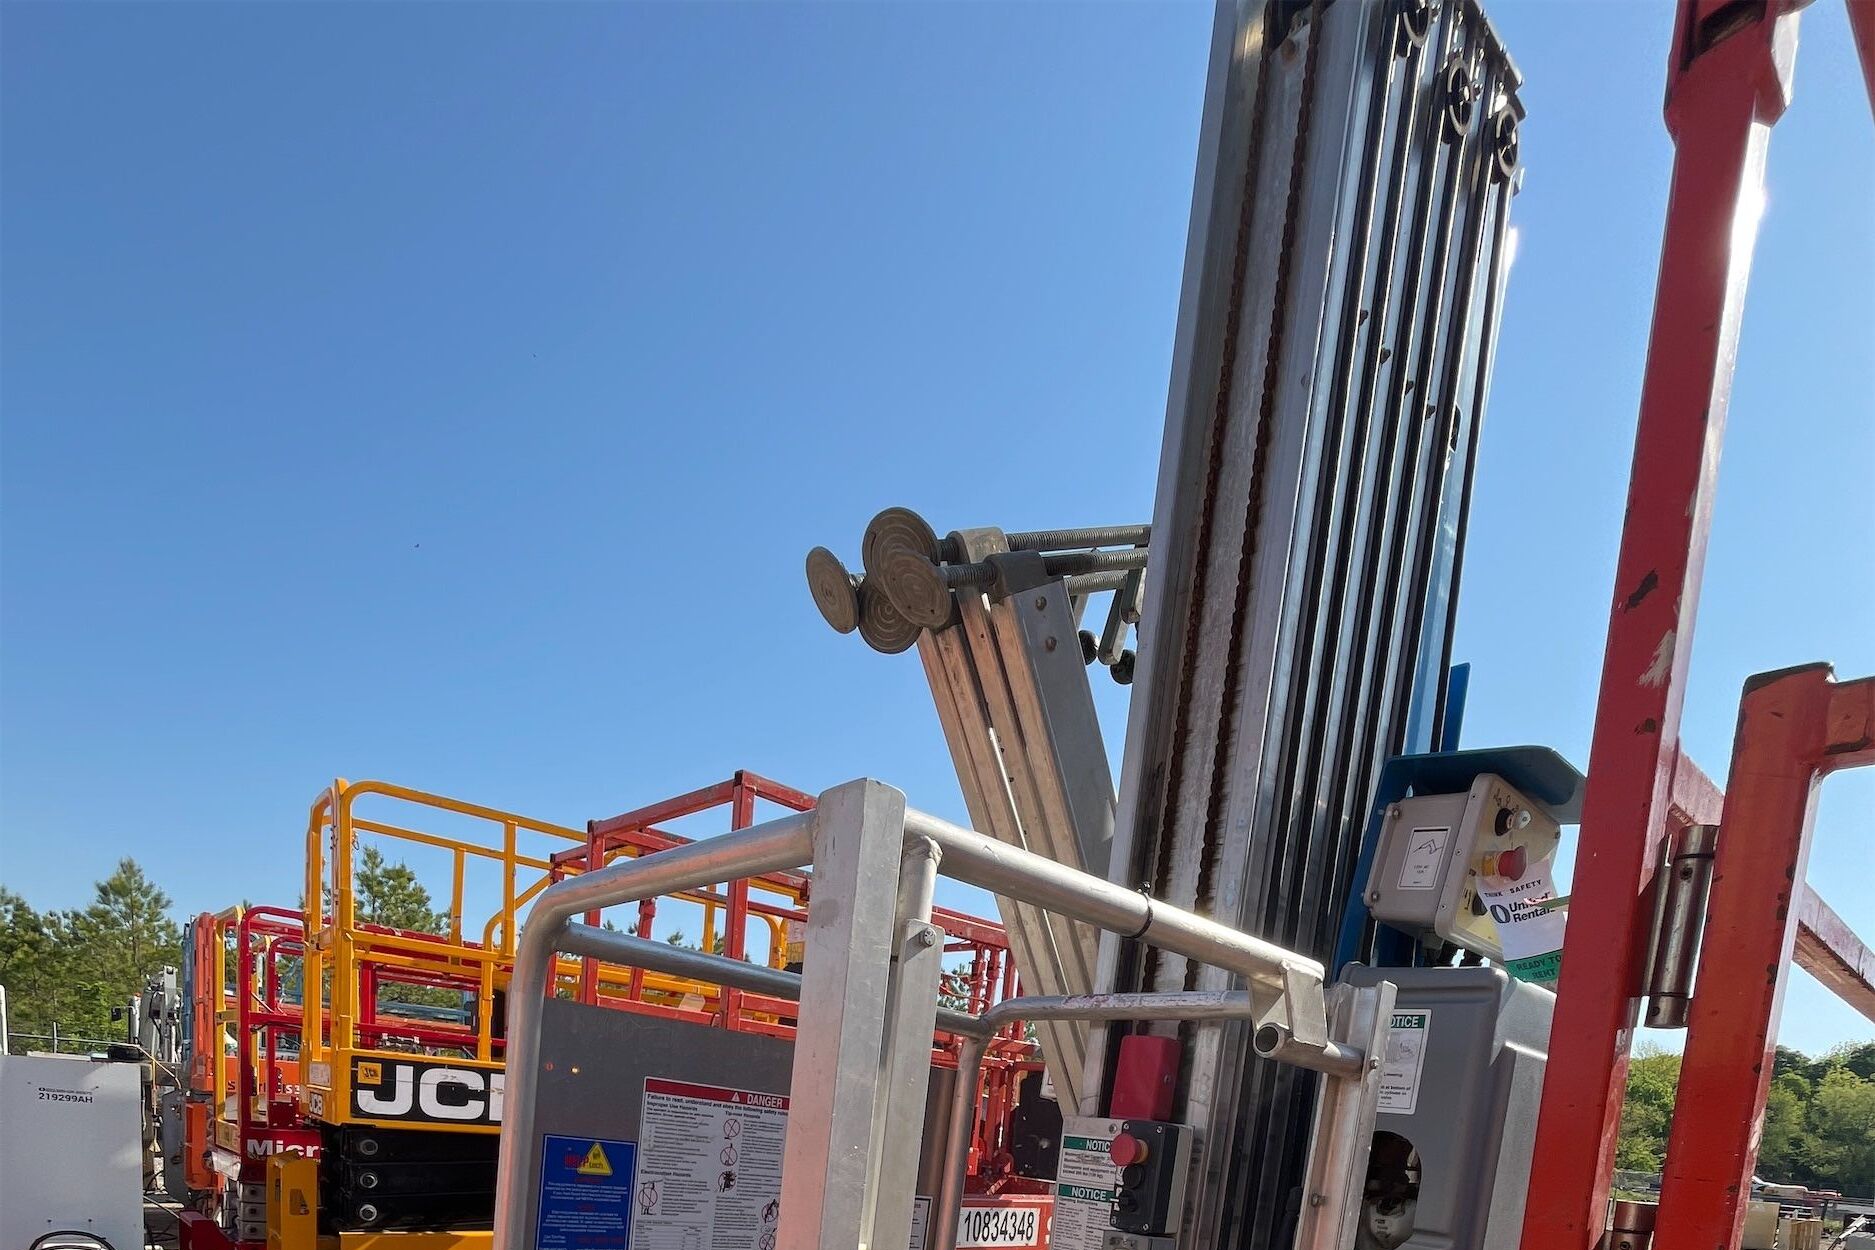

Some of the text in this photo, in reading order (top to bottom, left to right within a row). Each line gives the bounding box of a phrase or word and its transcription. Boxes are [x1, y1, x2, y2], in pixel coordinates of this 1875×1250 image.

[1510, 880, 1541, 894] SAFETY
[1516, 955, 1562, 971] READY TO
[1532, 968, 1555, 980] RENT
[1390, 1016, 1420, 1027] OTICE
[39, 1092, 93, 1103] 219299AH
[357, 1065, 505, 1121] JC
[747, 1093, 782, 1108] DANGER
[1086, 1139, 1110, 1152] NOTIC
[1071, 1186, 1106, 1201] NOTICE
[964, 1210, 1034, 1242] 10834348
